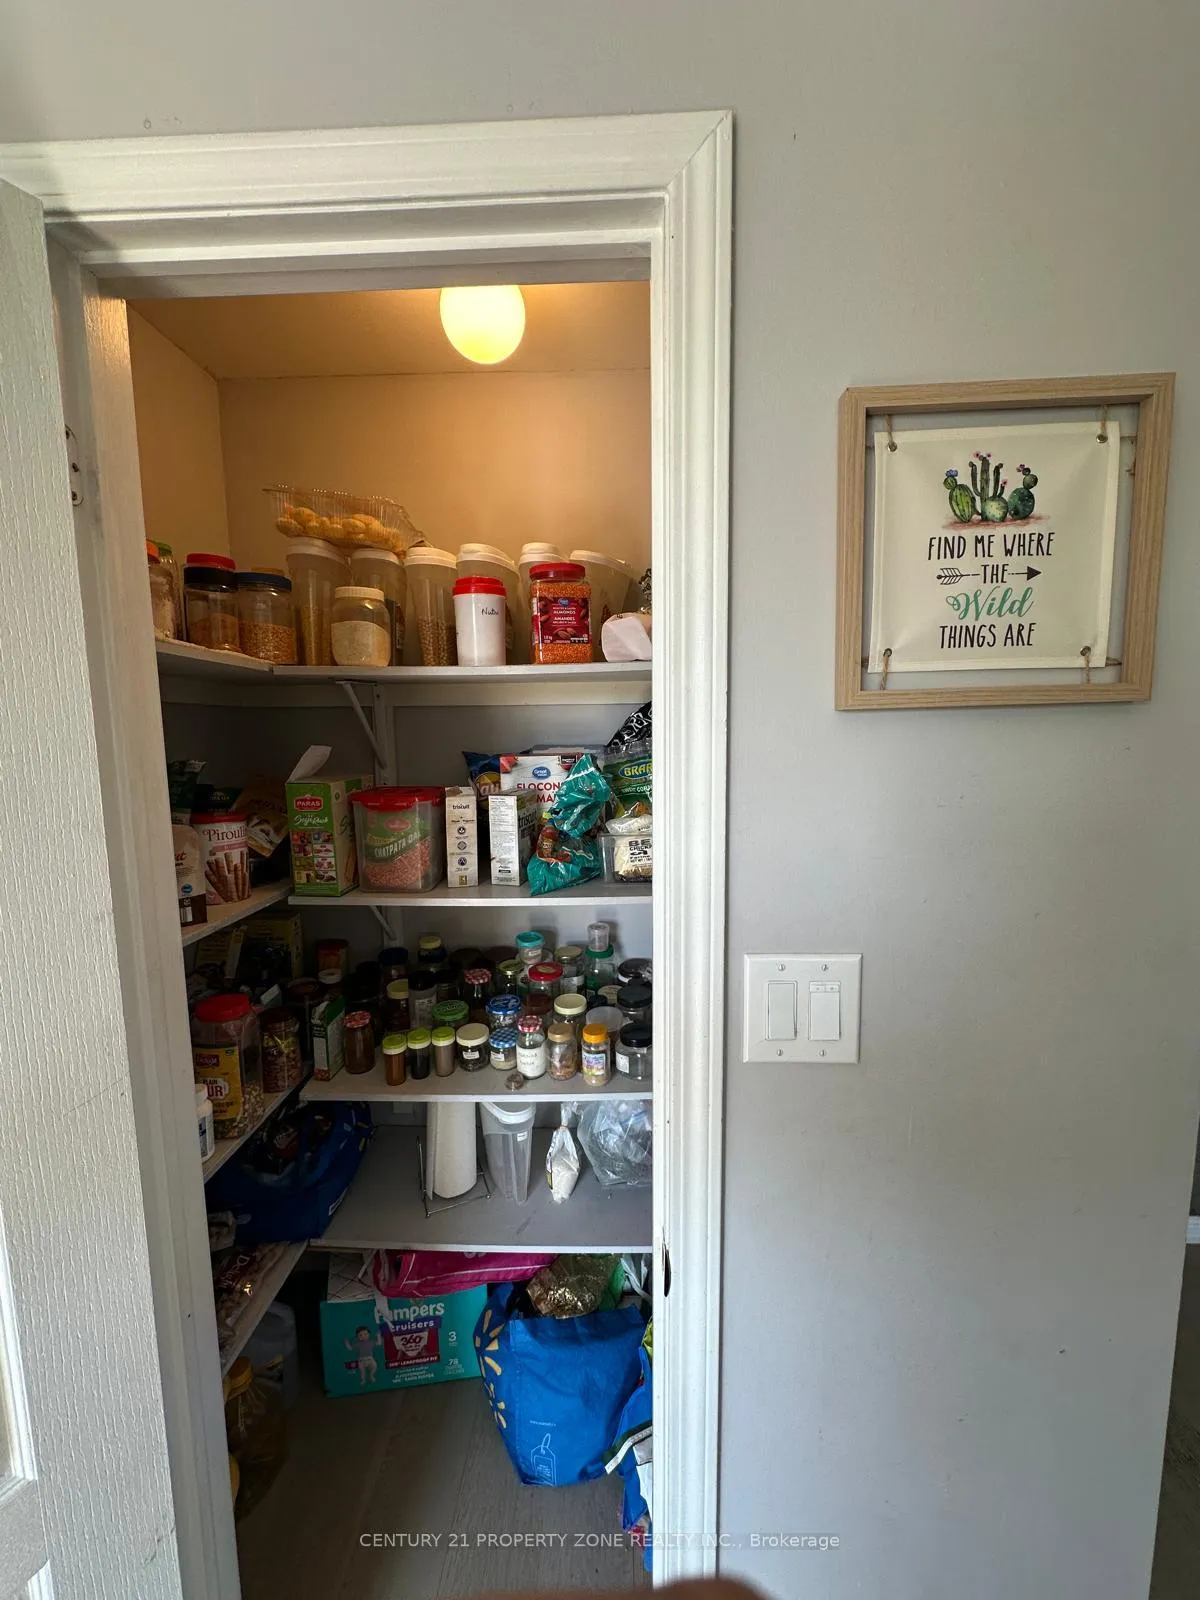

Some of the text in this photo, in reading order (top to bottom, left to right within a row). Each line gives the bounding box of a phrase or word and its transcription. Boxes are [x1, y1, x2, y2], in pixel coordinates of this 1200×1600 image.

[928, 532, 1055, 560] FIND ME WHERE
[981, 564, 1009, 584] THE
[946, 586, 1034, 621] Wild
[939, 622, 1036, 649] THINGS ARE
[516, 782, 562, 791] FLOCON
[296, 799, 321, 807] PARAS
[448, 1331, 457, 1342] 3
